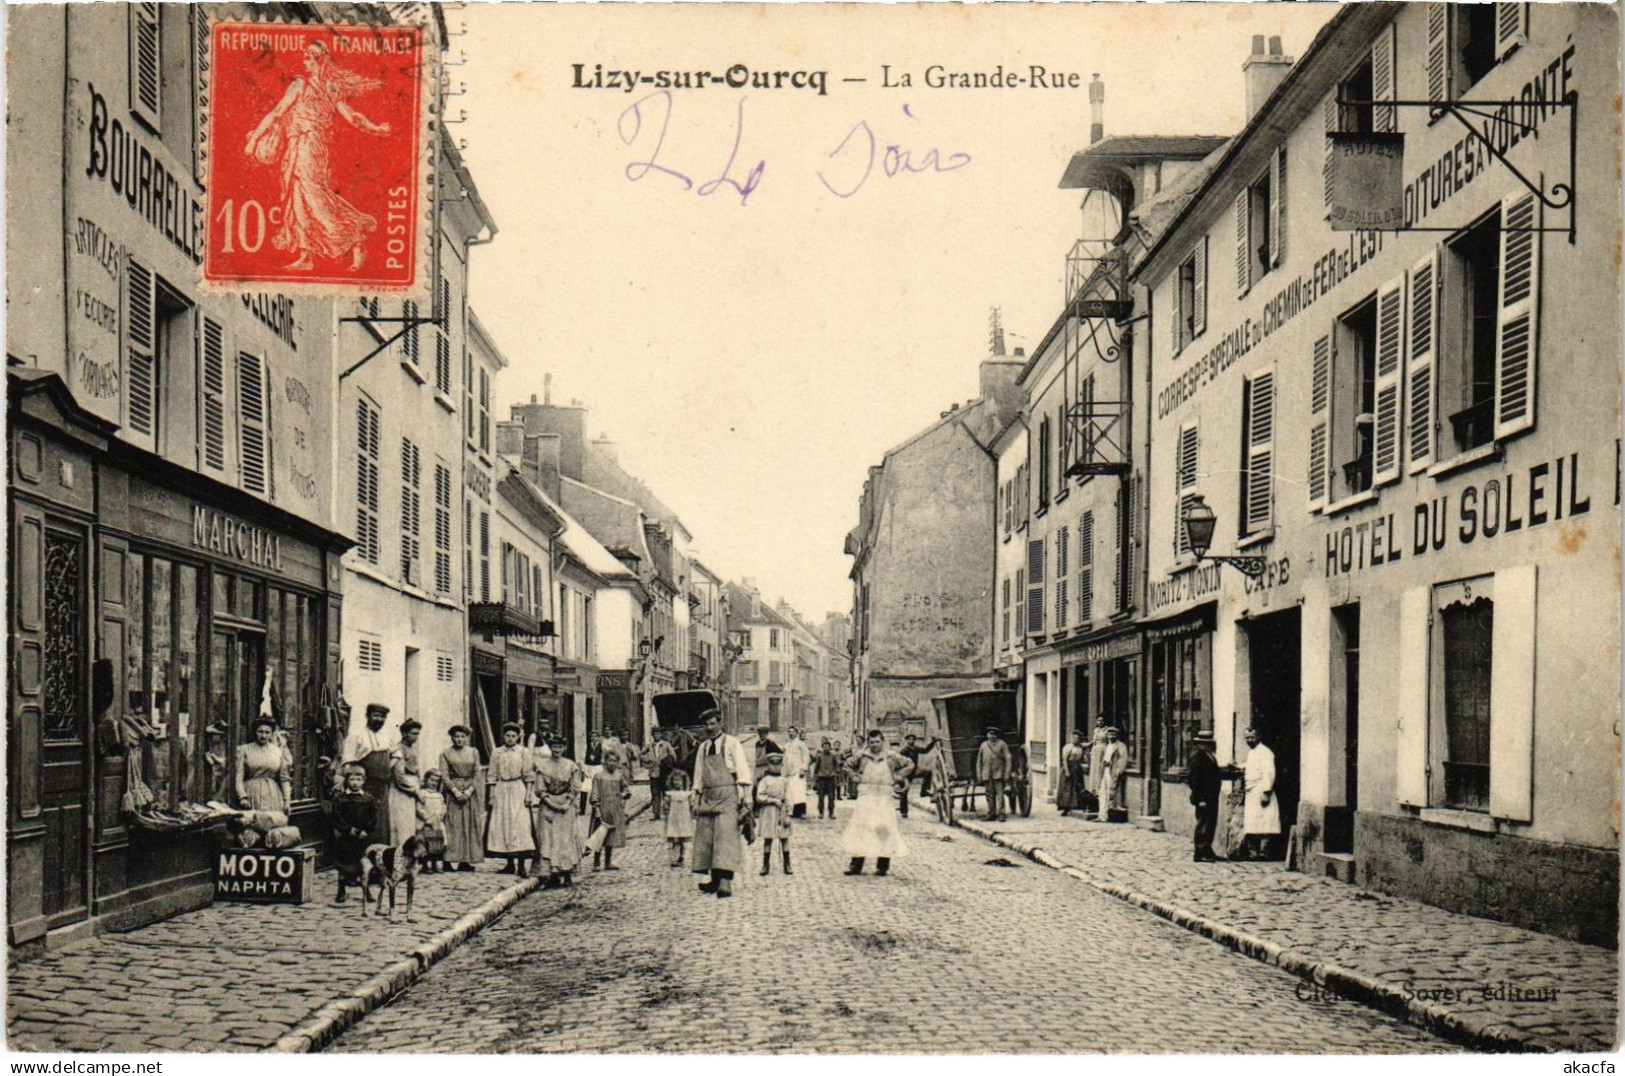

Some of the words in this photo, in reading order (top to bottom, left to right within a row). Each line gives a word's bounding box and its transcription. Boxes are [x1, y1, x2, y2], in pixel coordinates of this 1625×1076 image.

[571, 63, 829, 95] Lizy-sur-Ourcq
[881, 65, 912, 88] La
[925, 64, 1081, 89] Grande-Rue
[385, 186, 408, 270] POSTES
[1263, 274, 1301, 338] CHEMIN
[1302, 278, 1312, 310] DE
[1313, 248, 1336, 301] FER
[1337, 249, 1349, 283] DE
[1394, 131, 1475, 238] OITURES
[192, 505, 285, 572] MARCHAL
[1325, 513, 1402, 578] HÔTEL
[1413, 496, 1448, 556] DU
[1458, 452, 1591, 545] SOLEIL
[217, 880, 292, 895] NAPHTA
[219, 854, 296, 879] MOTO
